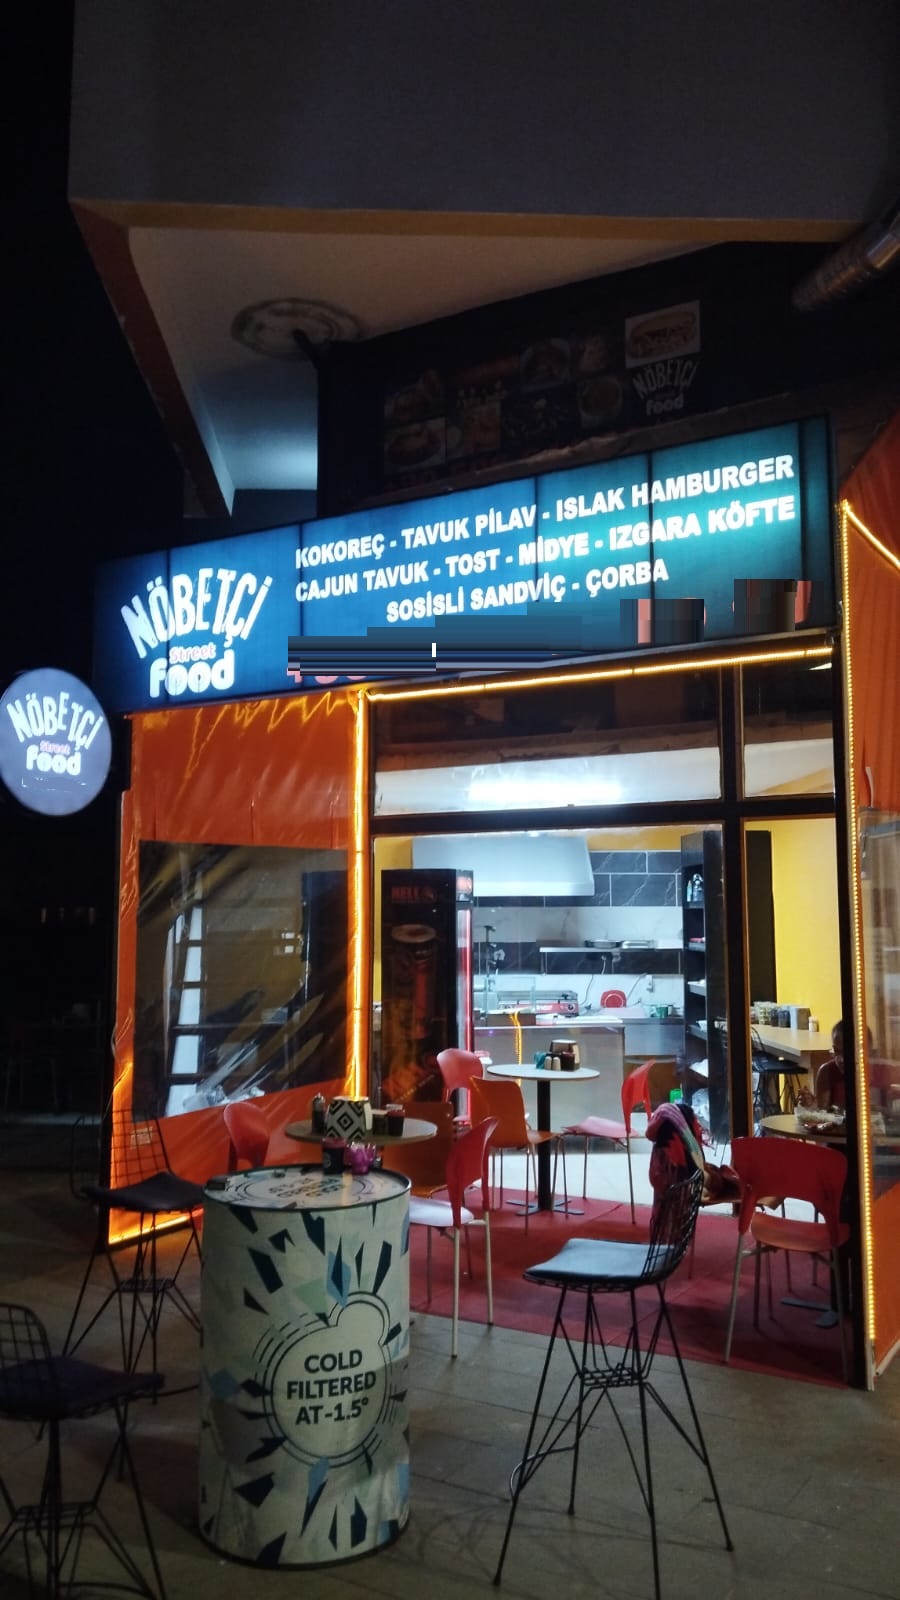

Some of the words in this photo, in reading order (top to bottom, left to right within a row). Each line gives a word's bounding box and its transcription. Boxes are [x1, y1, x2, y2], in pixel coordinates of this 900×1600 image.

[296, 534, 385, 568] KOKOREÇ
[402, 518, 469, 549] TAVUK
[476, 505, 536, 536] PİLAV
[557, 488, 624, 521] ISLAK
[632, 455, 794, 507] HAMBURGER
[296, 573, 358, 602] CAJUN
[363, 561, 428, 590] TAVUK
[445, 549, 500, 577] TOST
[519, 532, 589, 566] MİDYE
[609, 513, 702, 550] IZGARA
[708, 496, 795, 533] KÖFTE
[387, 585, 464, 622] SOSİSLİ
[471, 572, 566, 610] SANDVİÇ
[586, 559, 668, 597] ÇORBA
[287, 1371, 376, 1400] FILTERED
[304, 1349, 362, 1373] COLD
